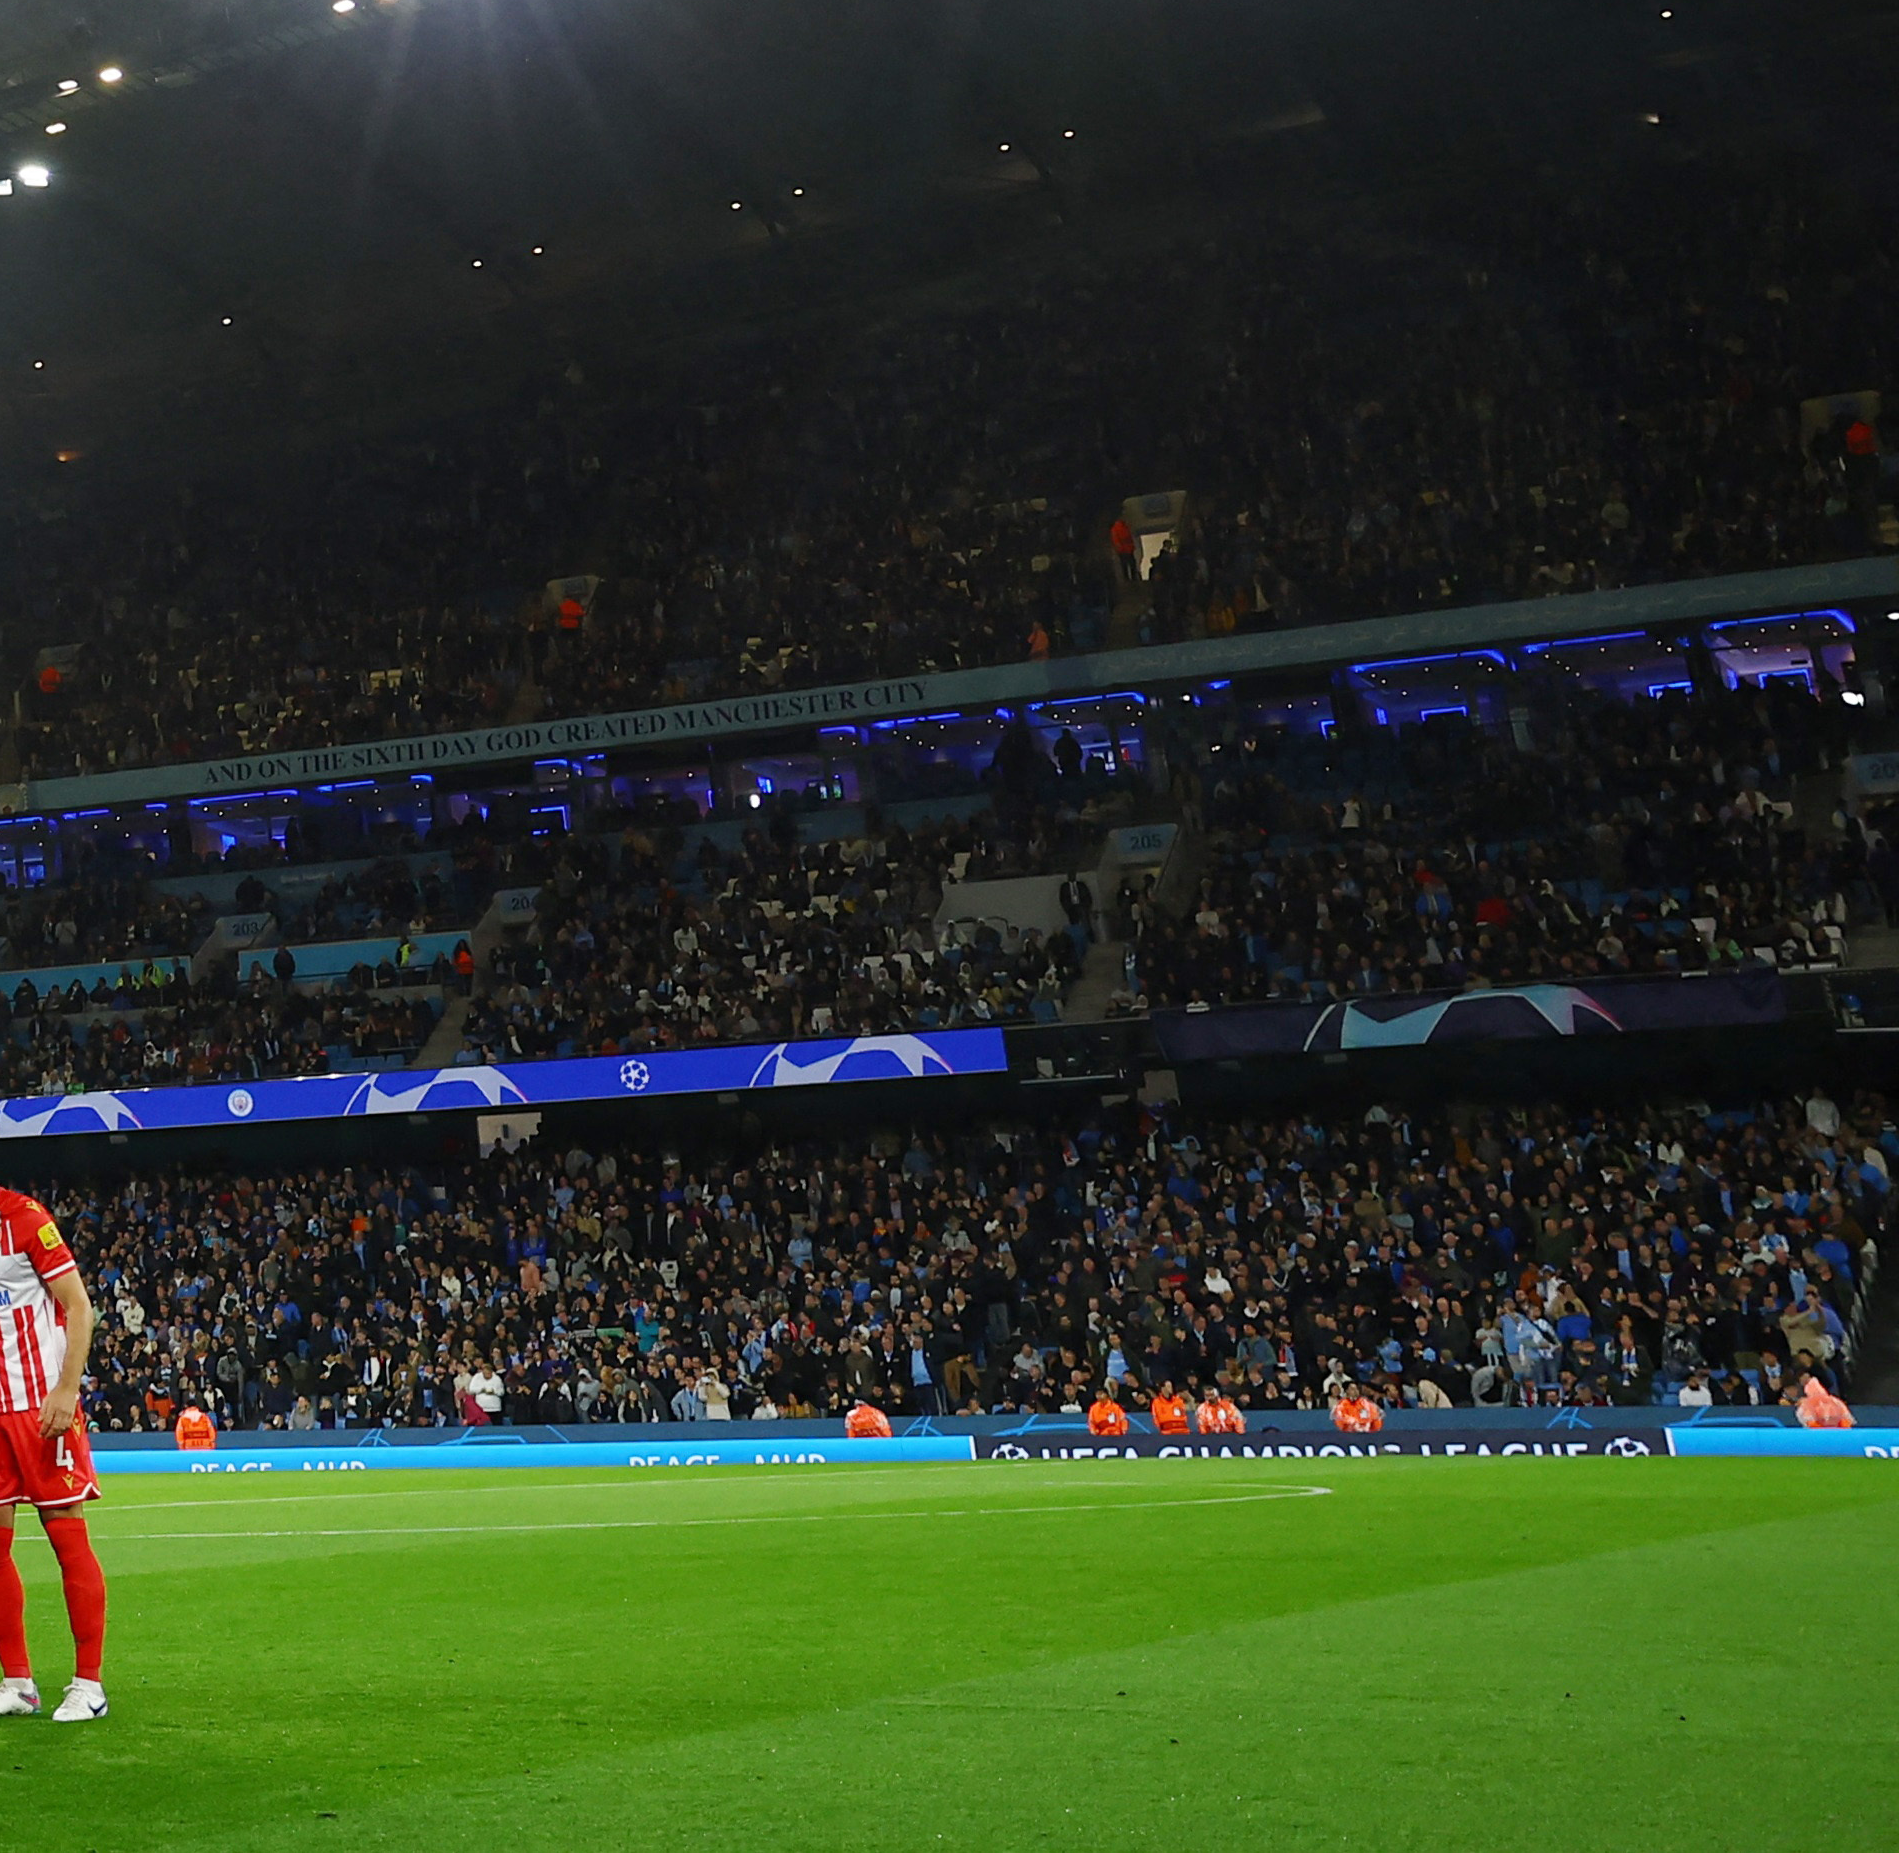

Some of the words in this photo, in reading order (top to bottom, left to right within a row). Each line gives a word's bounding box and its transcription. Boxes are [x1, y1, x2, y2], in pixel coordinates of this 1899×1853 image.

[205, 763, 252, 785] AND
[258, 758, 291, 778] ON
[298, 751, 347, 773] THE
[353, 743, 424, 768] SIXTH
[432, 735, 479, 758] DAY
[486, 728, 541, 752] GOD
[547, 714, 666, 744] CREATED
[673, 690, 857, 732] MANCHESTER
[863, 680, 928, 707] CITY
[1130, 834, 1163, 850] 205
[56, 1436, 74, 1472] 4
